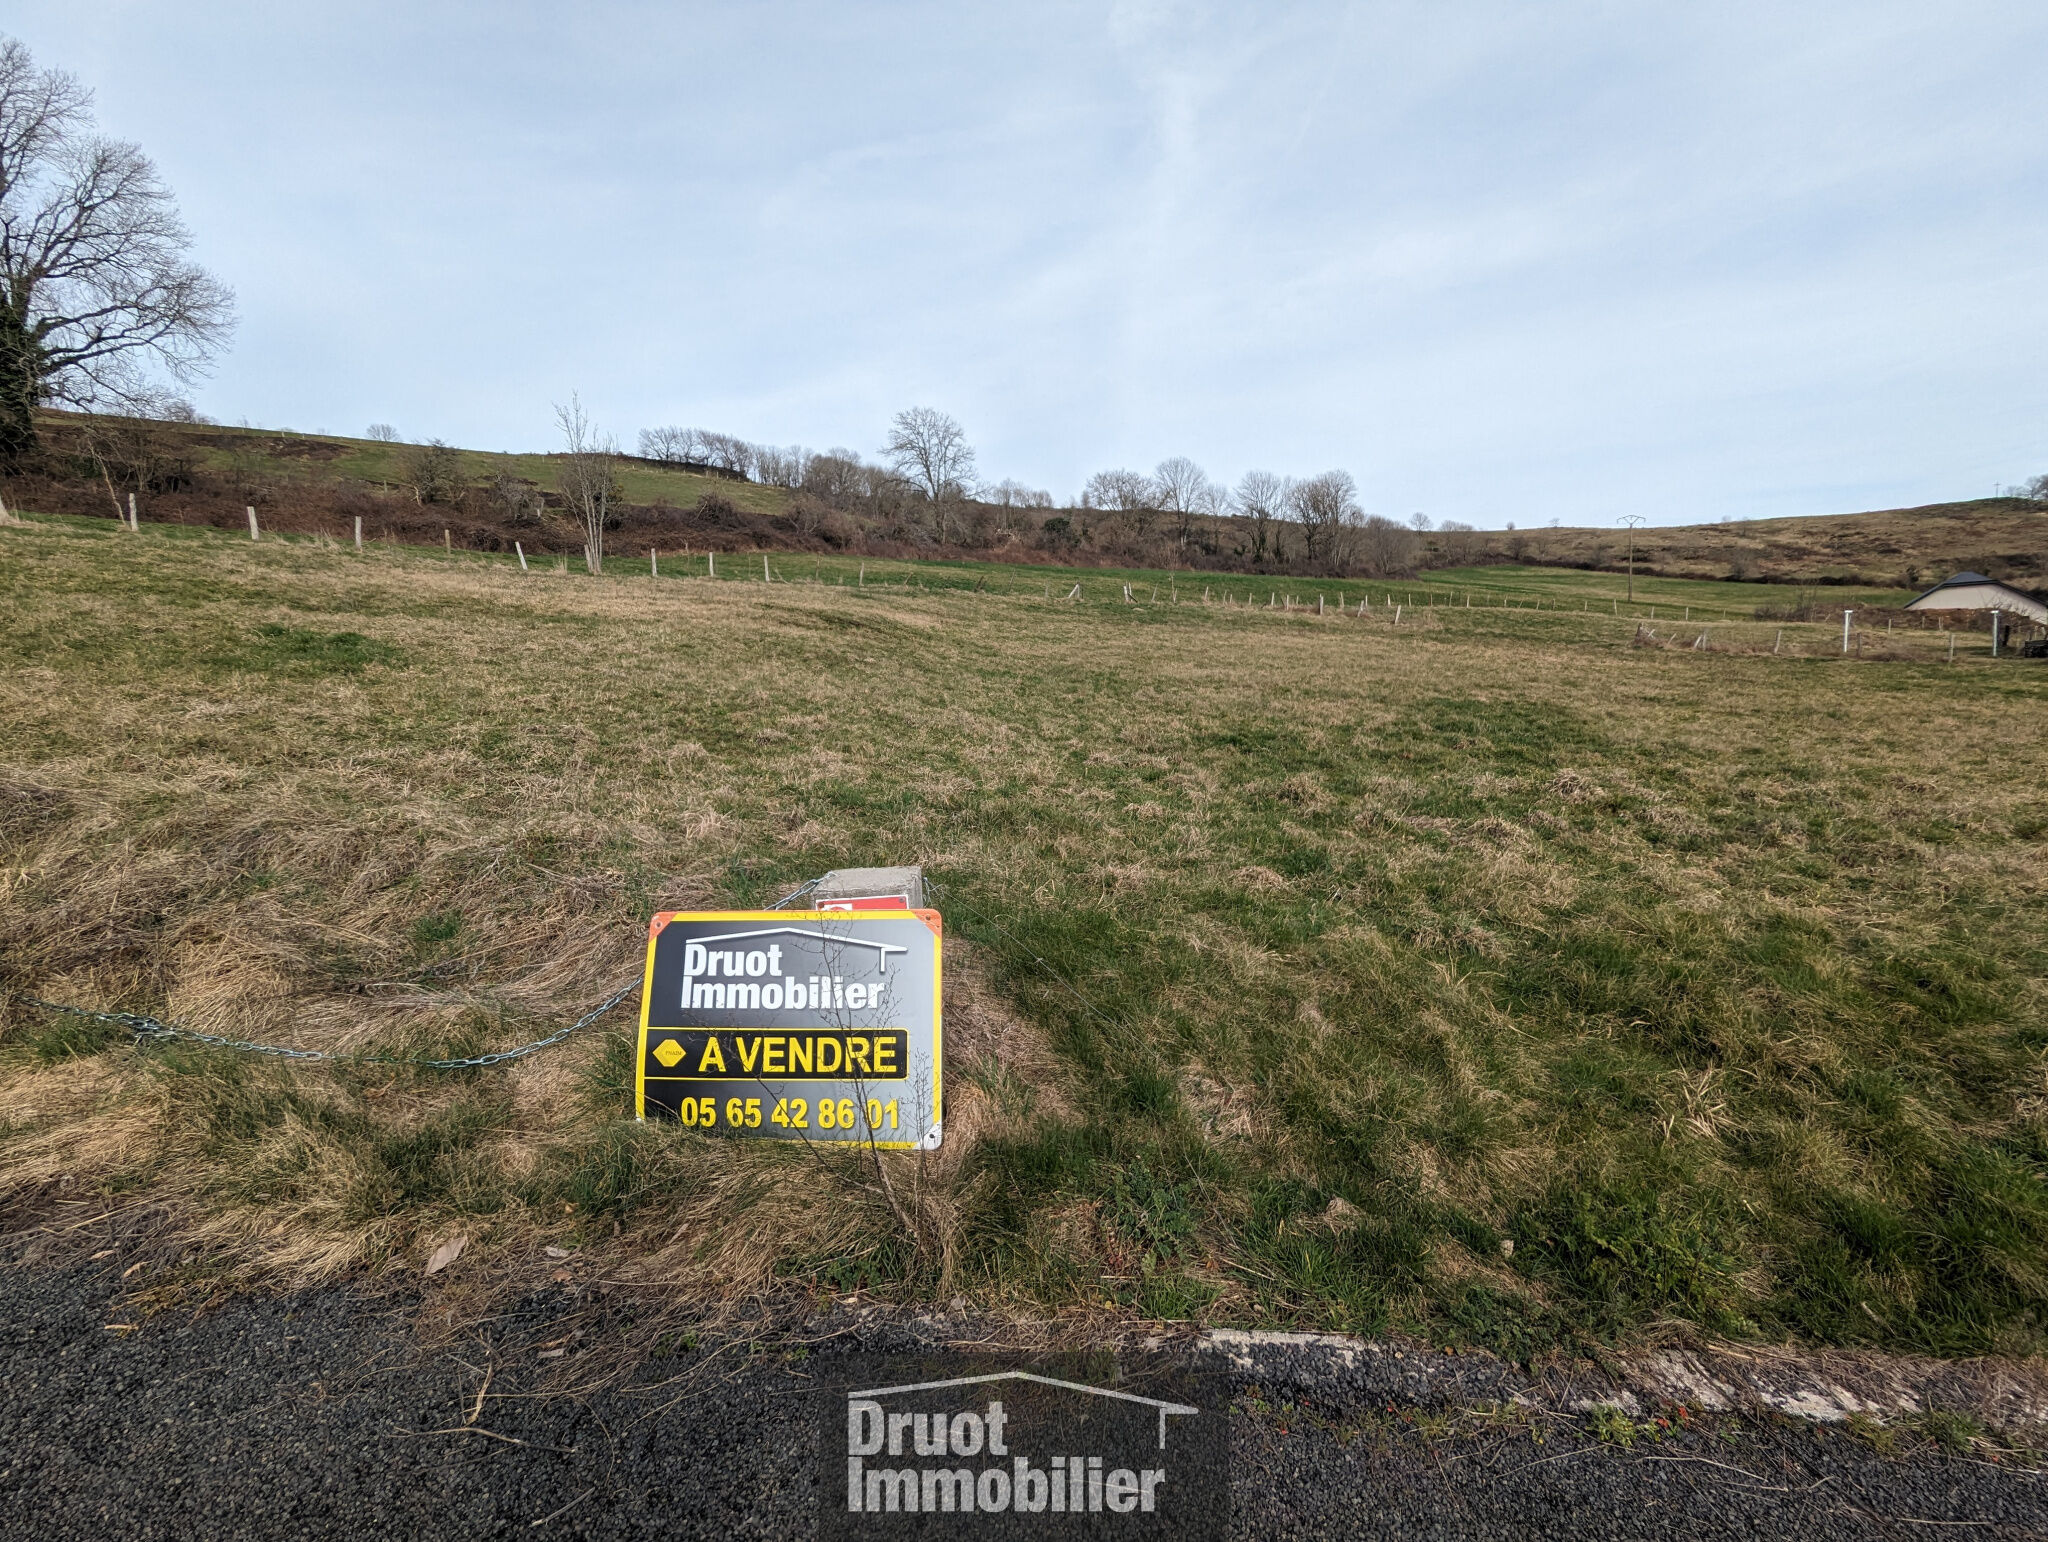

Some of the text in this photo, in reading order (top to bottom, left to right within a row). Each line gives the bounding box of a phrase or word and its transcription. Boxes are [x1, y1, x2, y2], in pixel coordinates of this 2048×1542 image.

[683, 944, 782, 977] Druot
[681, 975, 885, 1010] Immobilier
[698, 1037, 897, 1073] A VENDRE
[681, 1097, 899, 1129] 05 65 42 86 01
